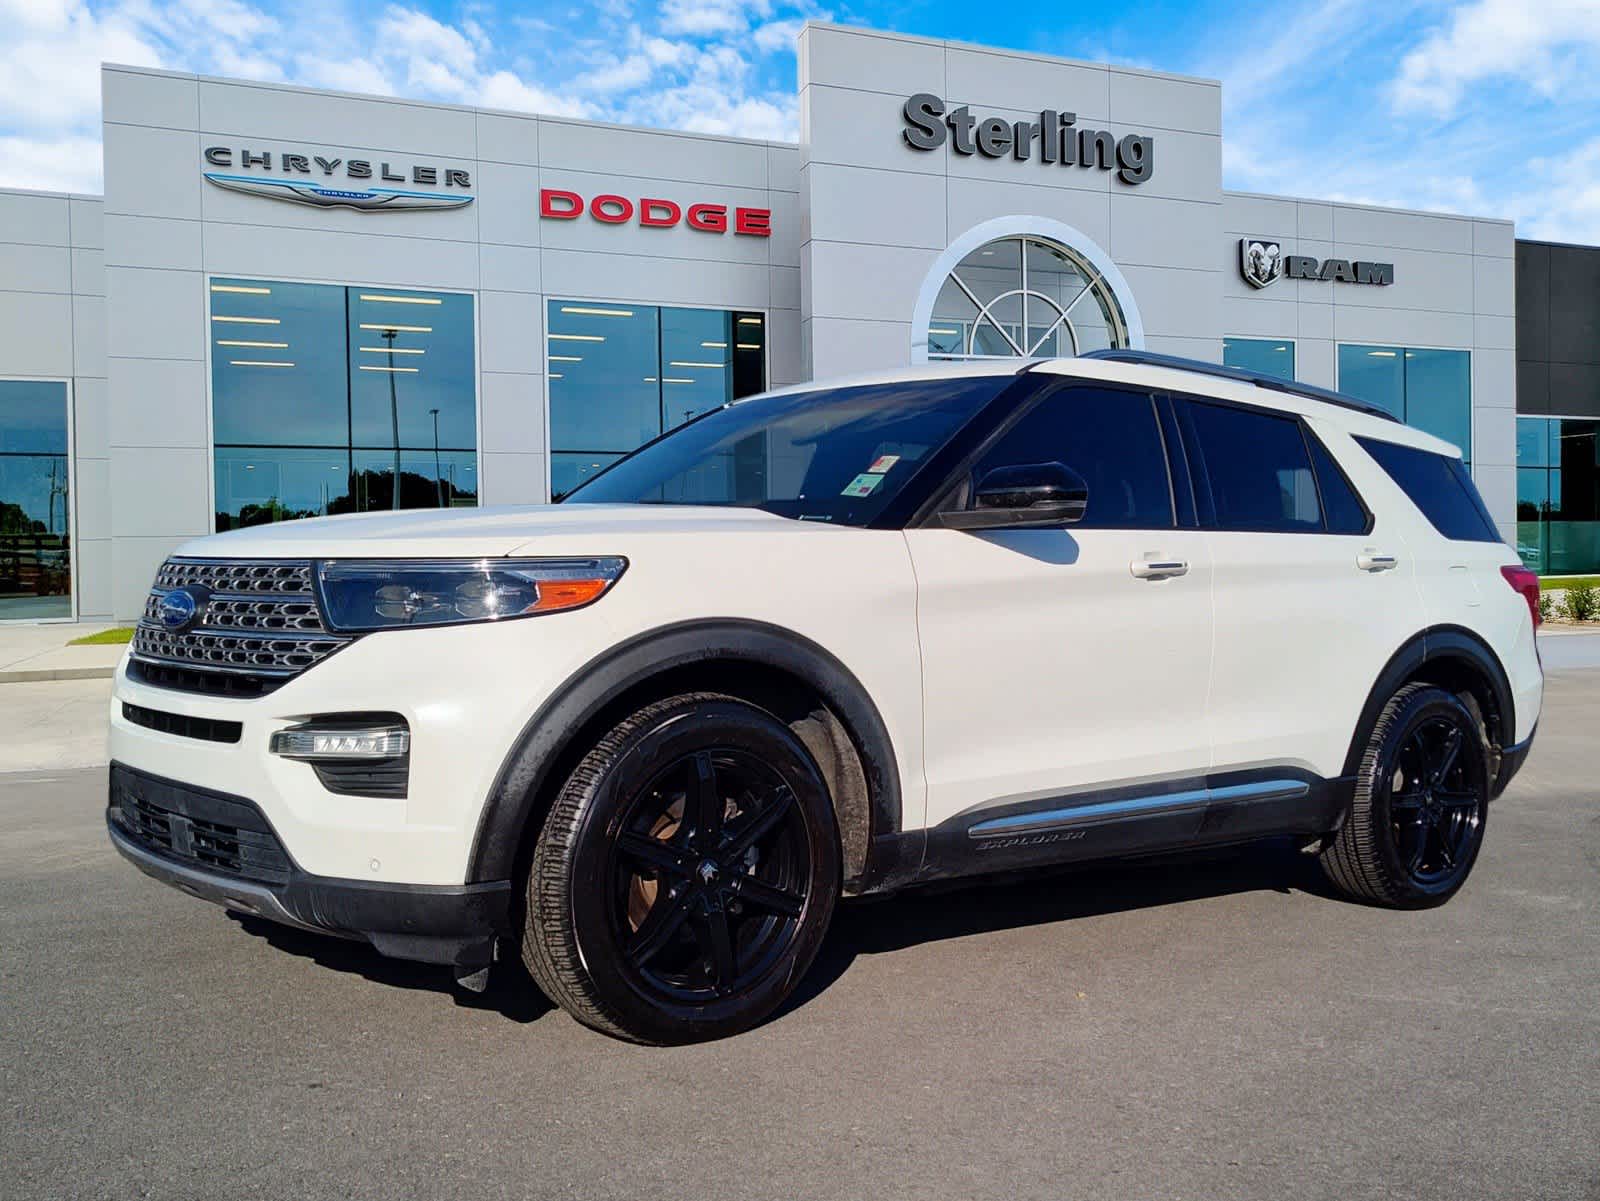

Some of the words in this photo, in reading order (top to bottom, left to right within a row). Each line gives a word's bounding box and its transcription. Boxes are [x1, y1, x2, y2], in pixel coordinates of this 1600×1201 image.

[903, 93, 1154, 184] Sterling
[204, 146, 472, 187] CHRYSLER
[539, 188, 772, 237] DODGE
[1284, 255, 1394, 286] RAM
